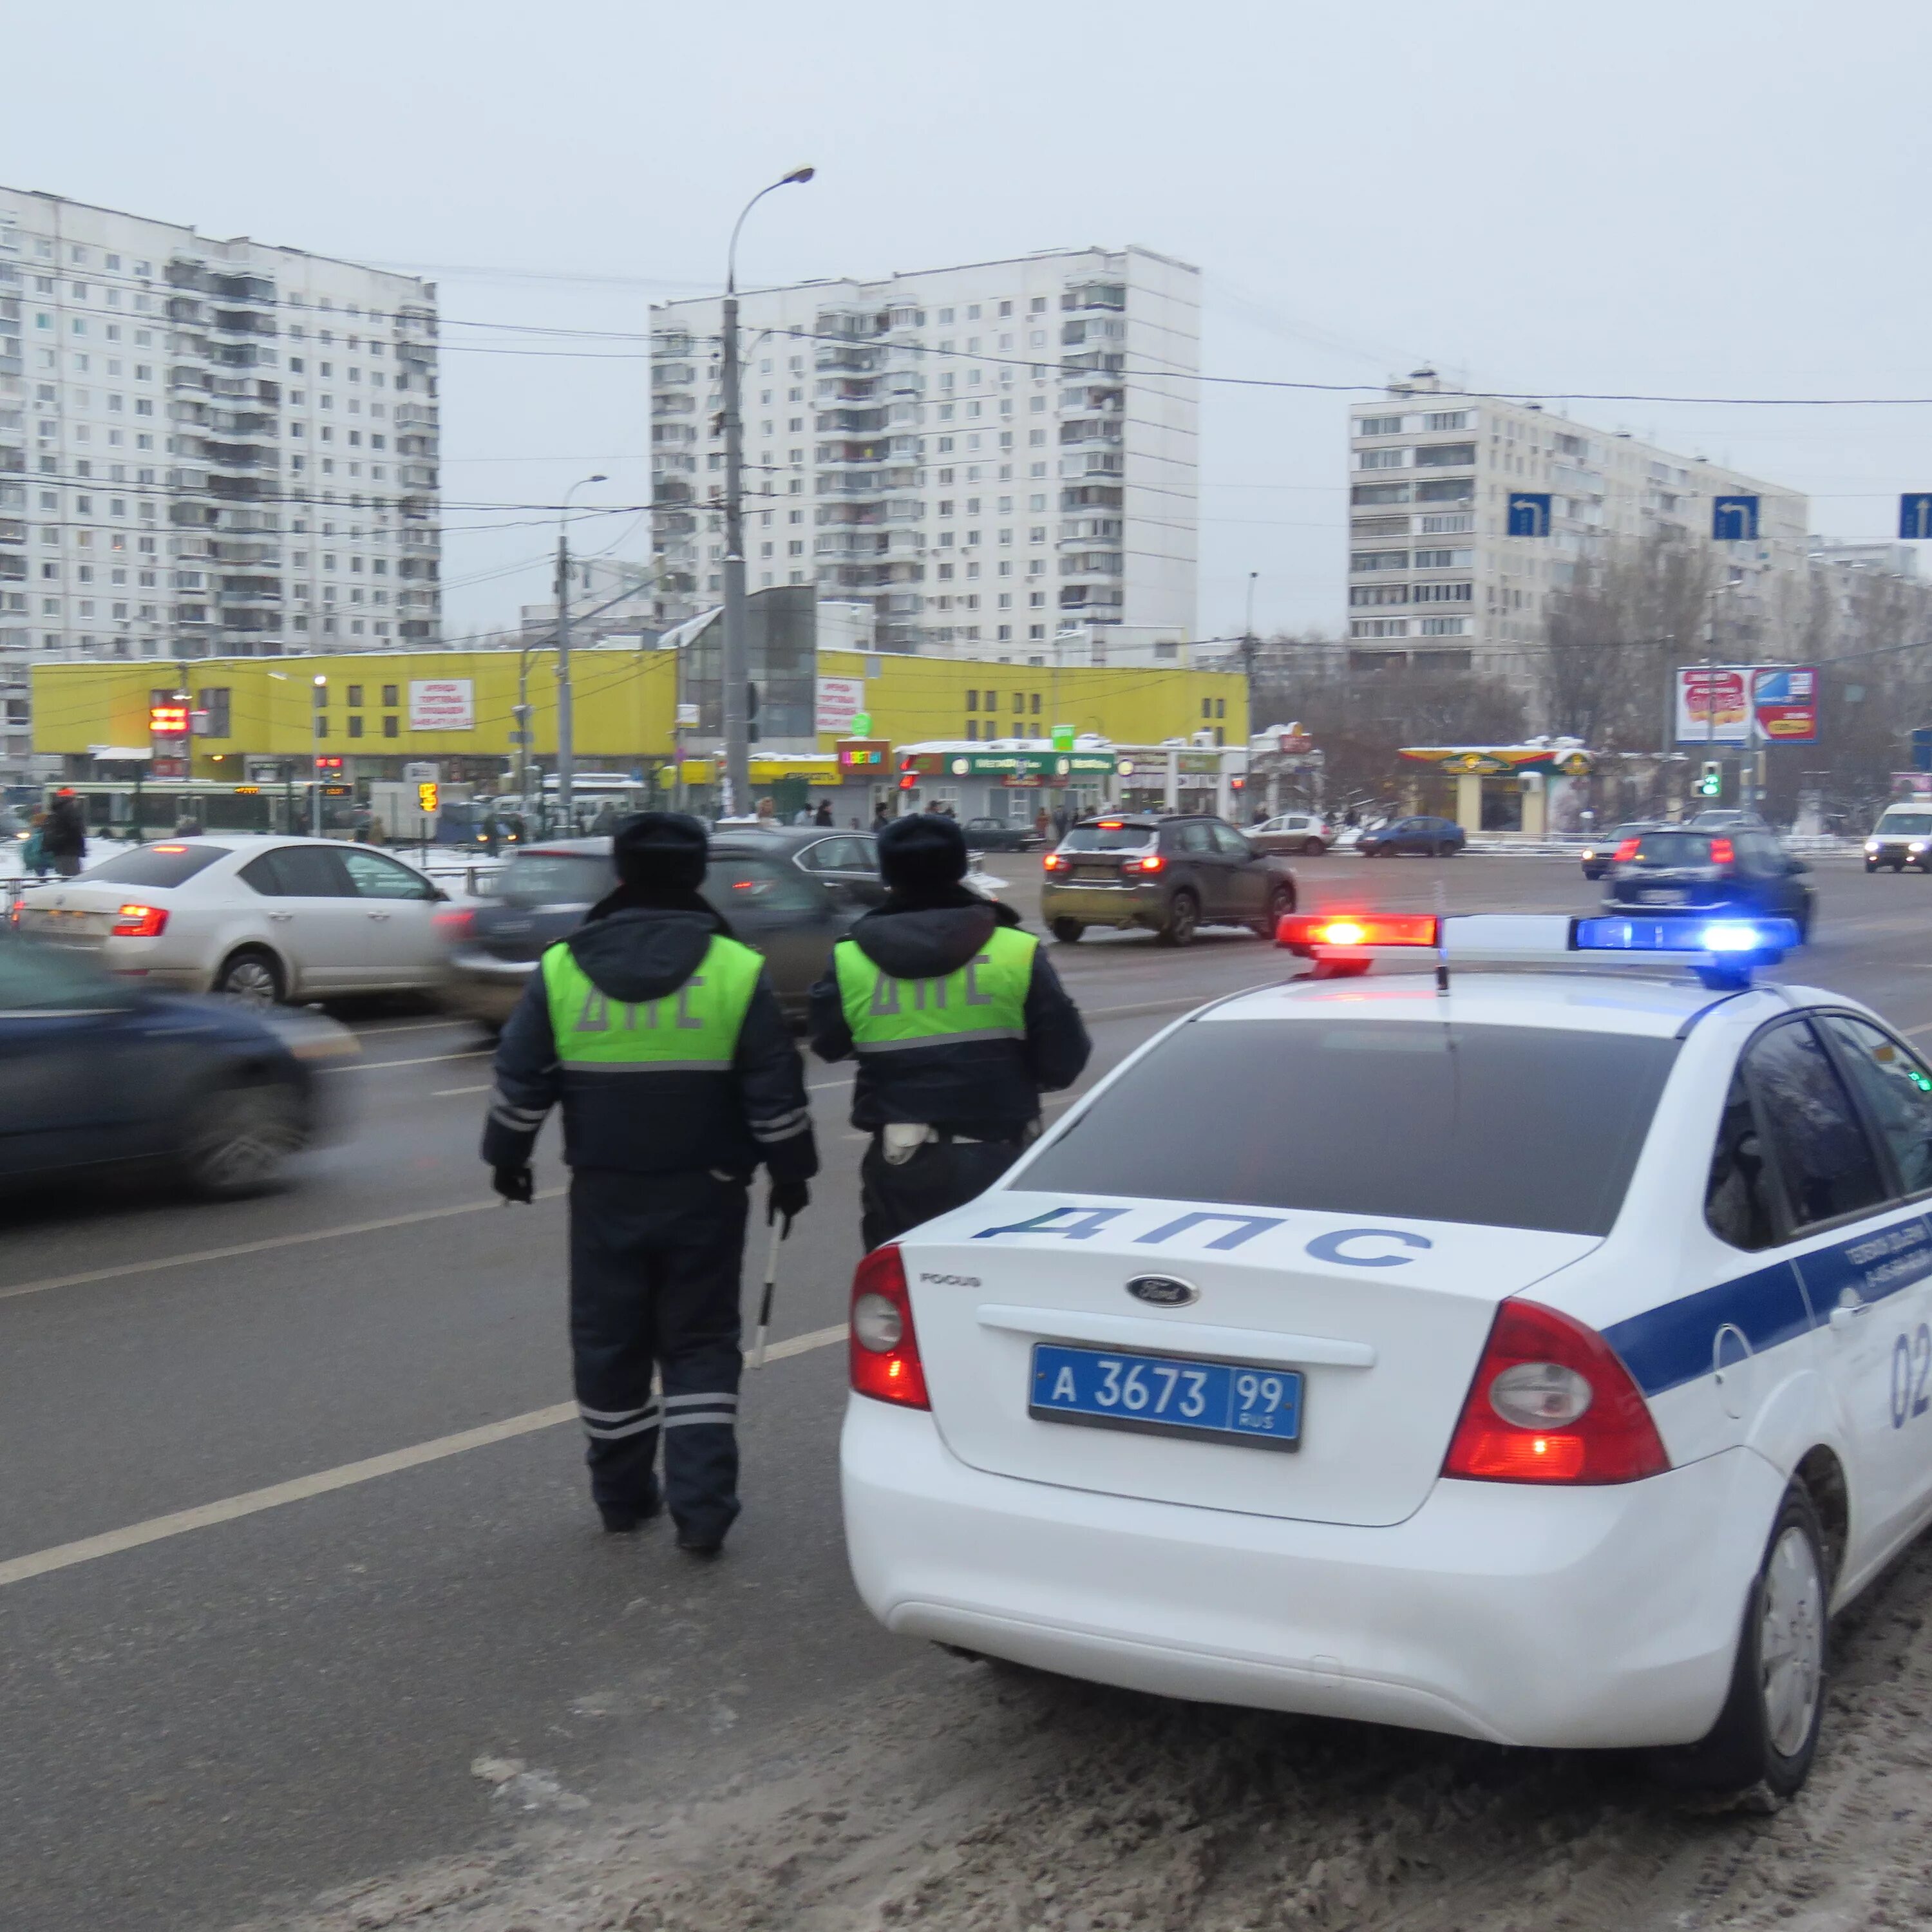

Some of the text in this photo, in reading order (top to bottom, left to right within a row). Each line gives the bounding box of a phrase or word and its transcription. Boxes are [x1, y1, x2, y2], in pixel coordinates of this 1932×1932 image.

[969, 1207, 1432, 1267] ДПС
[919, 1273, 982, 1288] FOCUS
[1095, 1361, 1208, 1417] 3673
[1236, 1374, 1283, 1413] 99
[1238, 1412, 1274, 1430] RUS
